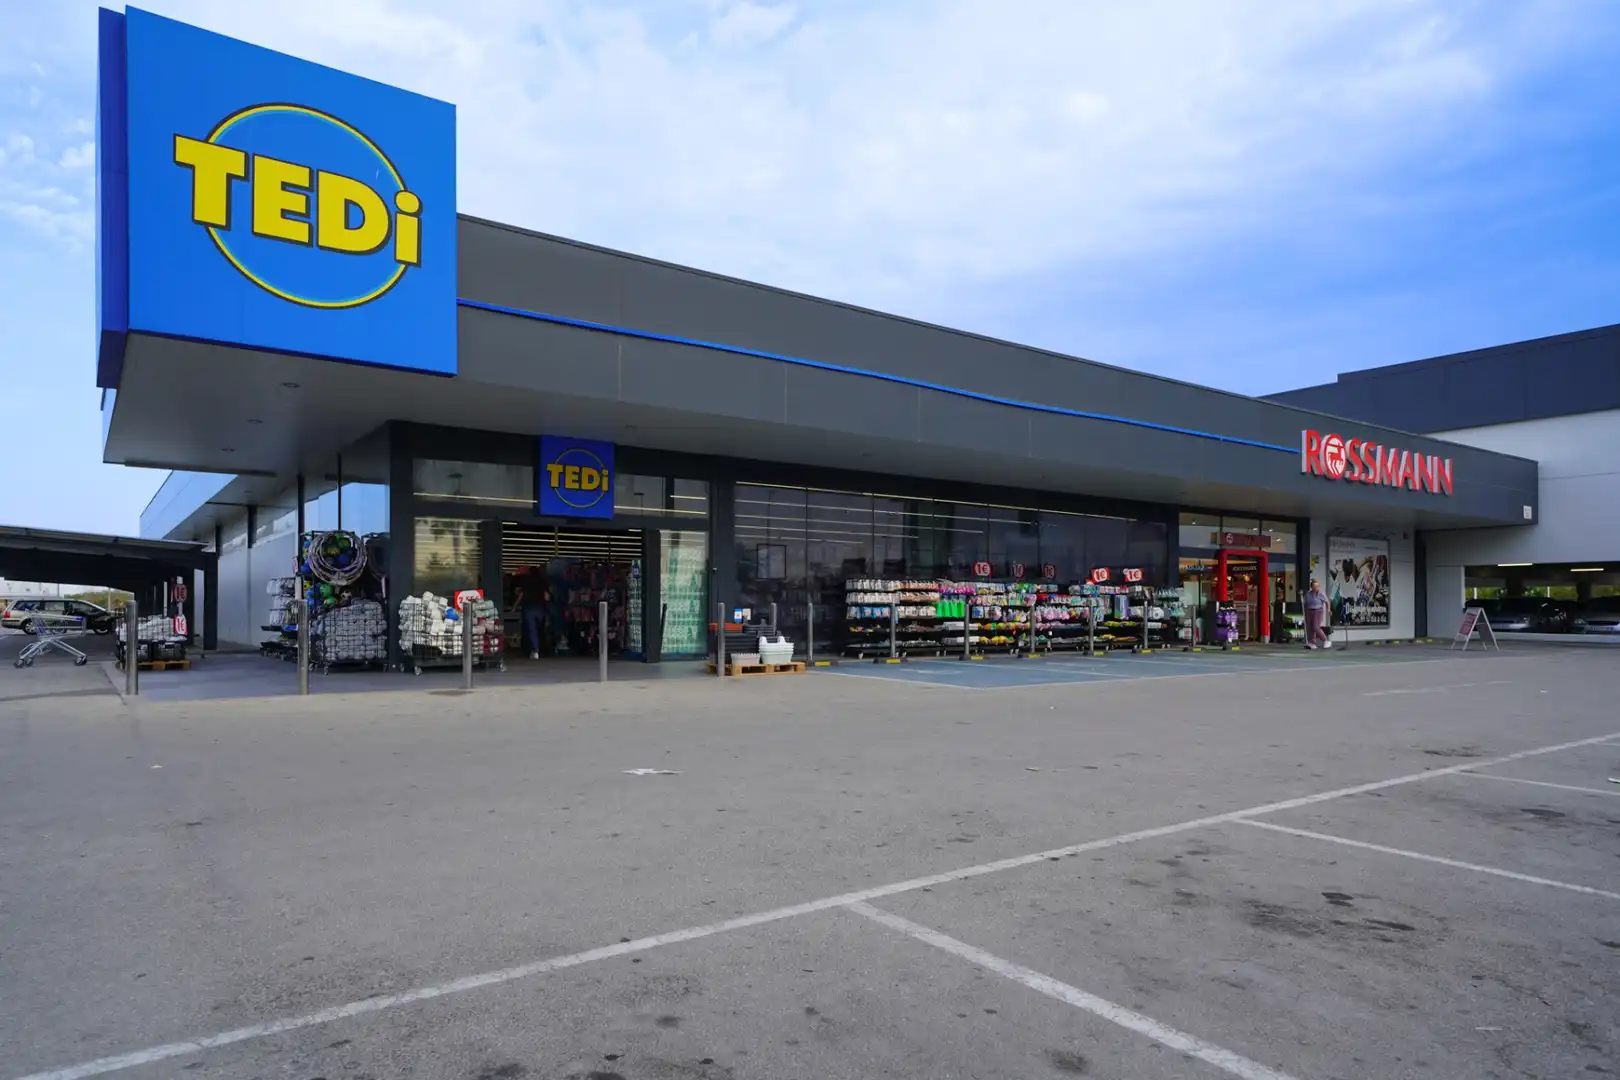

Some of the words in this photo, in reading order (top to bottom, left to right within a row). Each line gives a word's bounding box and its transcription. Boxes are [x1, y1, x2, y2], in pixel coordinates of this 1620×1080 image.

[173, 133, 424, 268] TEDi
[547, 463, 609, 492] TEDi
[1301, 429, 1453, 496] ROSSMANN
